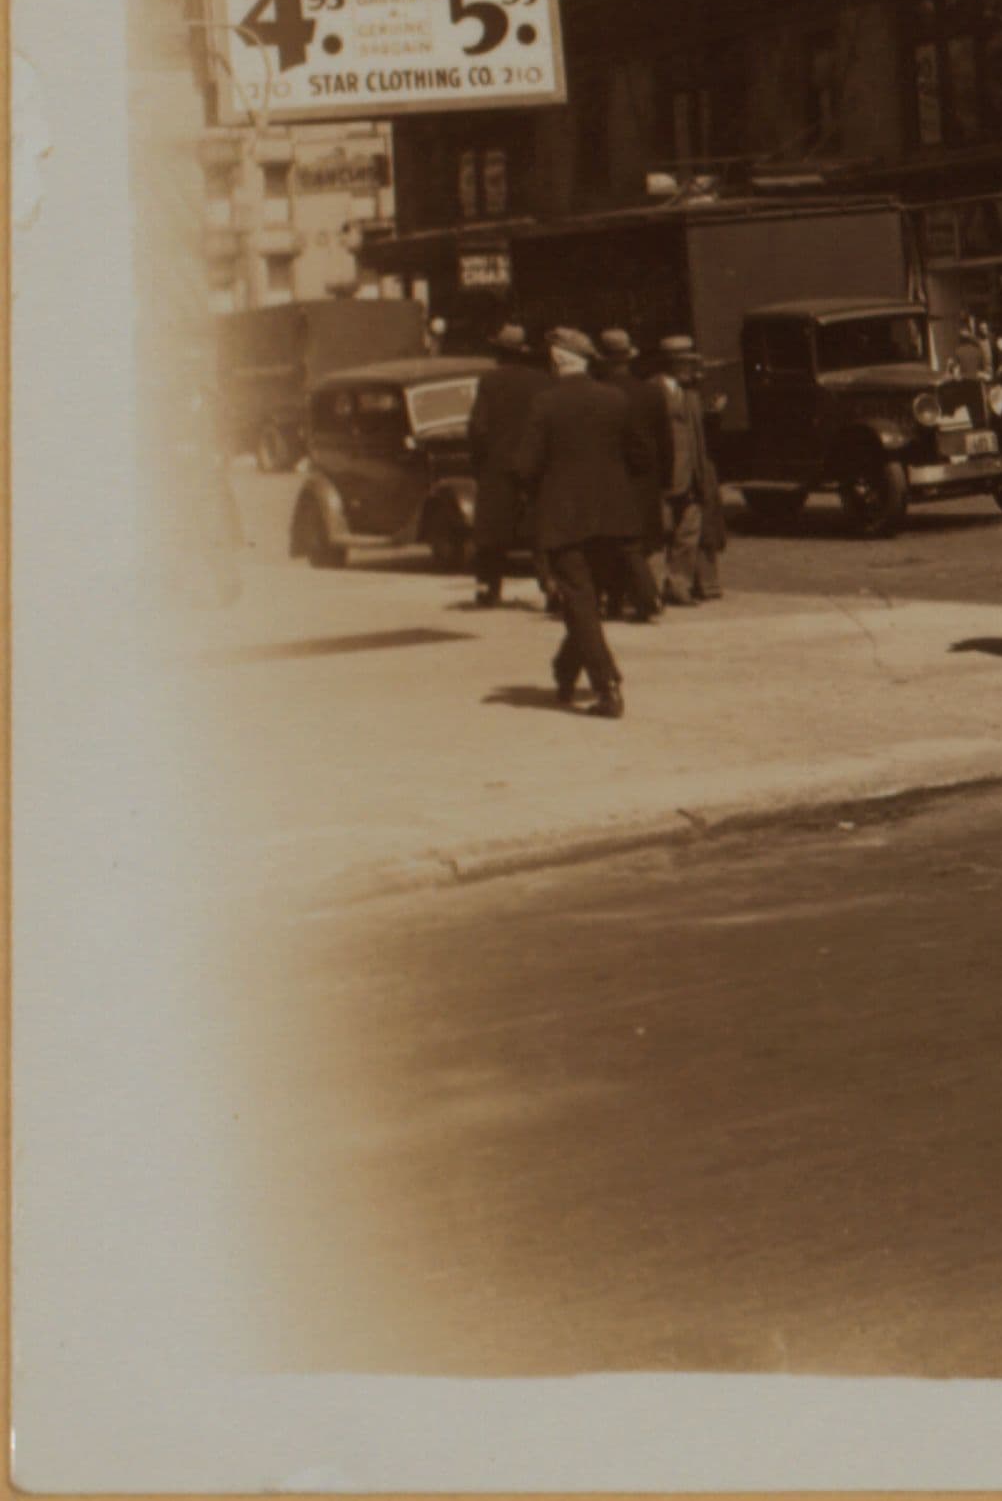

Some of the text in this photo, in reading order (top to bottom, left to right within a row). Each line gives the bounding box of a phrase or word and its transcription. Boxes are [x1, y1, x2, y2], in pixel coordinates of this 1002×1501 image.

[307, 69, 359, 96] STAR
[365, 66, 461, 92] CLOTHING
[501, 65, 543, 85] 210
